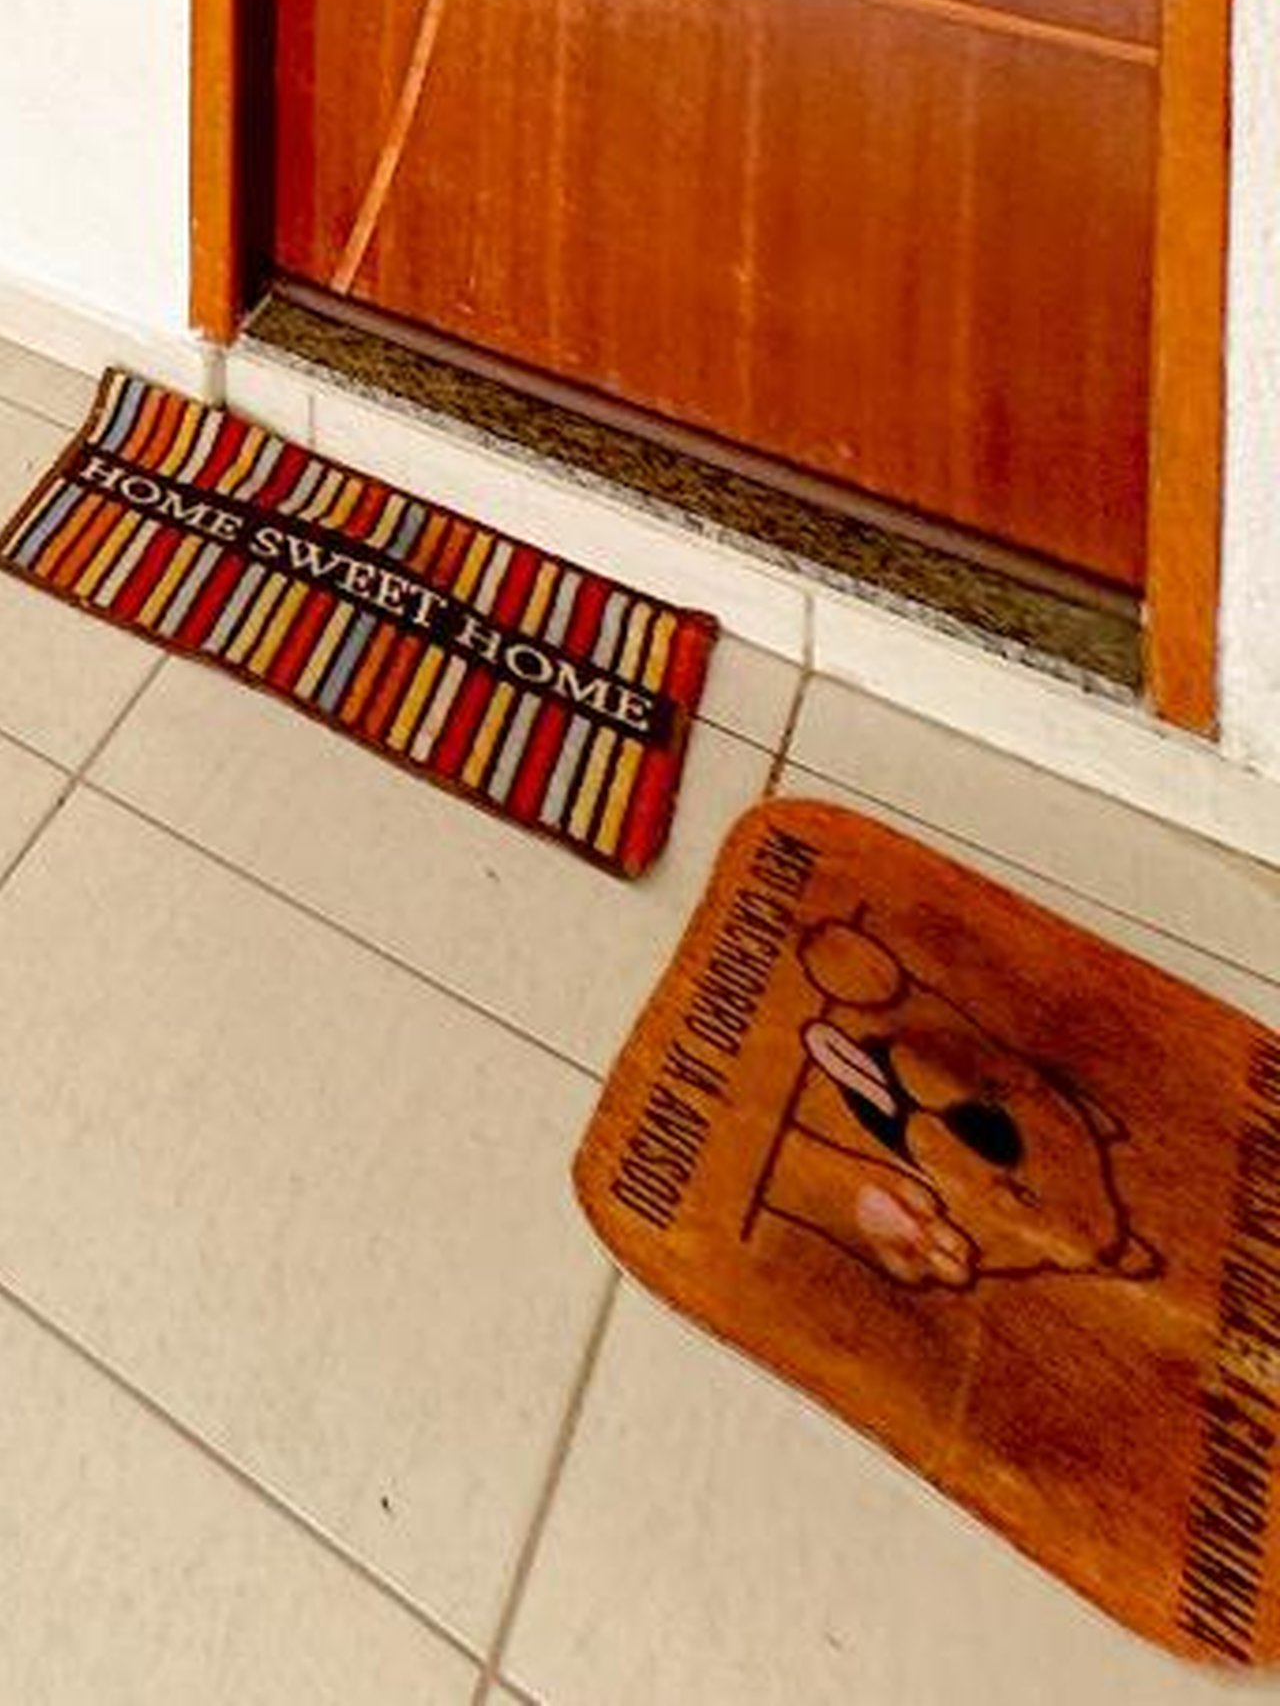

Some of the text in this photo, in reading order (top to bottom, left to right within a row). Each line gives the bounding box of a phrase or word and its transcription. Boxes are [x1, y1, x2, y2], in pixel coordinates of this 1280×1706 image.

[79, 456, 655, 733] HOME SWEET HOME
[750, 824, 821, 891] MEU
[684, 888, 798, 1058] CACHORRO
[609, 1082, 712, 1231] AVISOU
